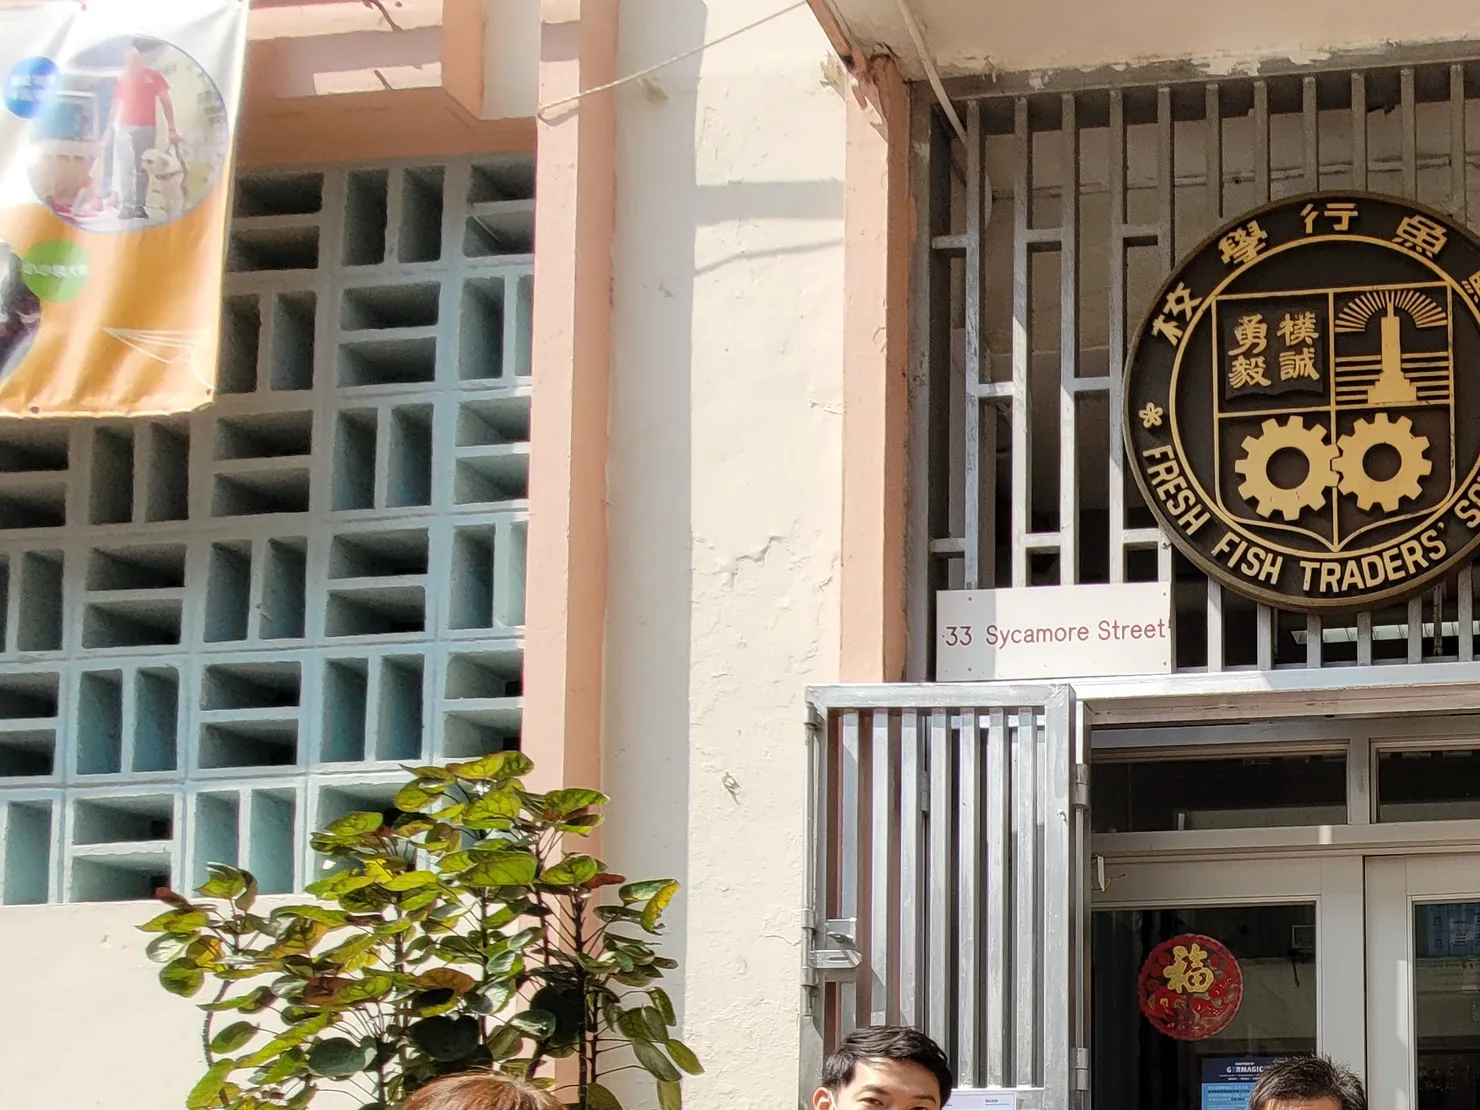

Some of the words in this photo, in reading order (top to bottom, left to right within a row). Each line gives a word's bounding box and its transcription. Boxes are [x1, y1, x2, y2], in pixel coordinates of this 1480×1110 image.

[1142, 444, 1210, 537] FRESH
[1211, 531, 1284, 585] FISH
[944, 625, 973, 647] 33
[985, 624, 1090, 650] Sycamore
[1097, 617, 1167, 641] Street
[1163, 943, 1215, 993] 福
